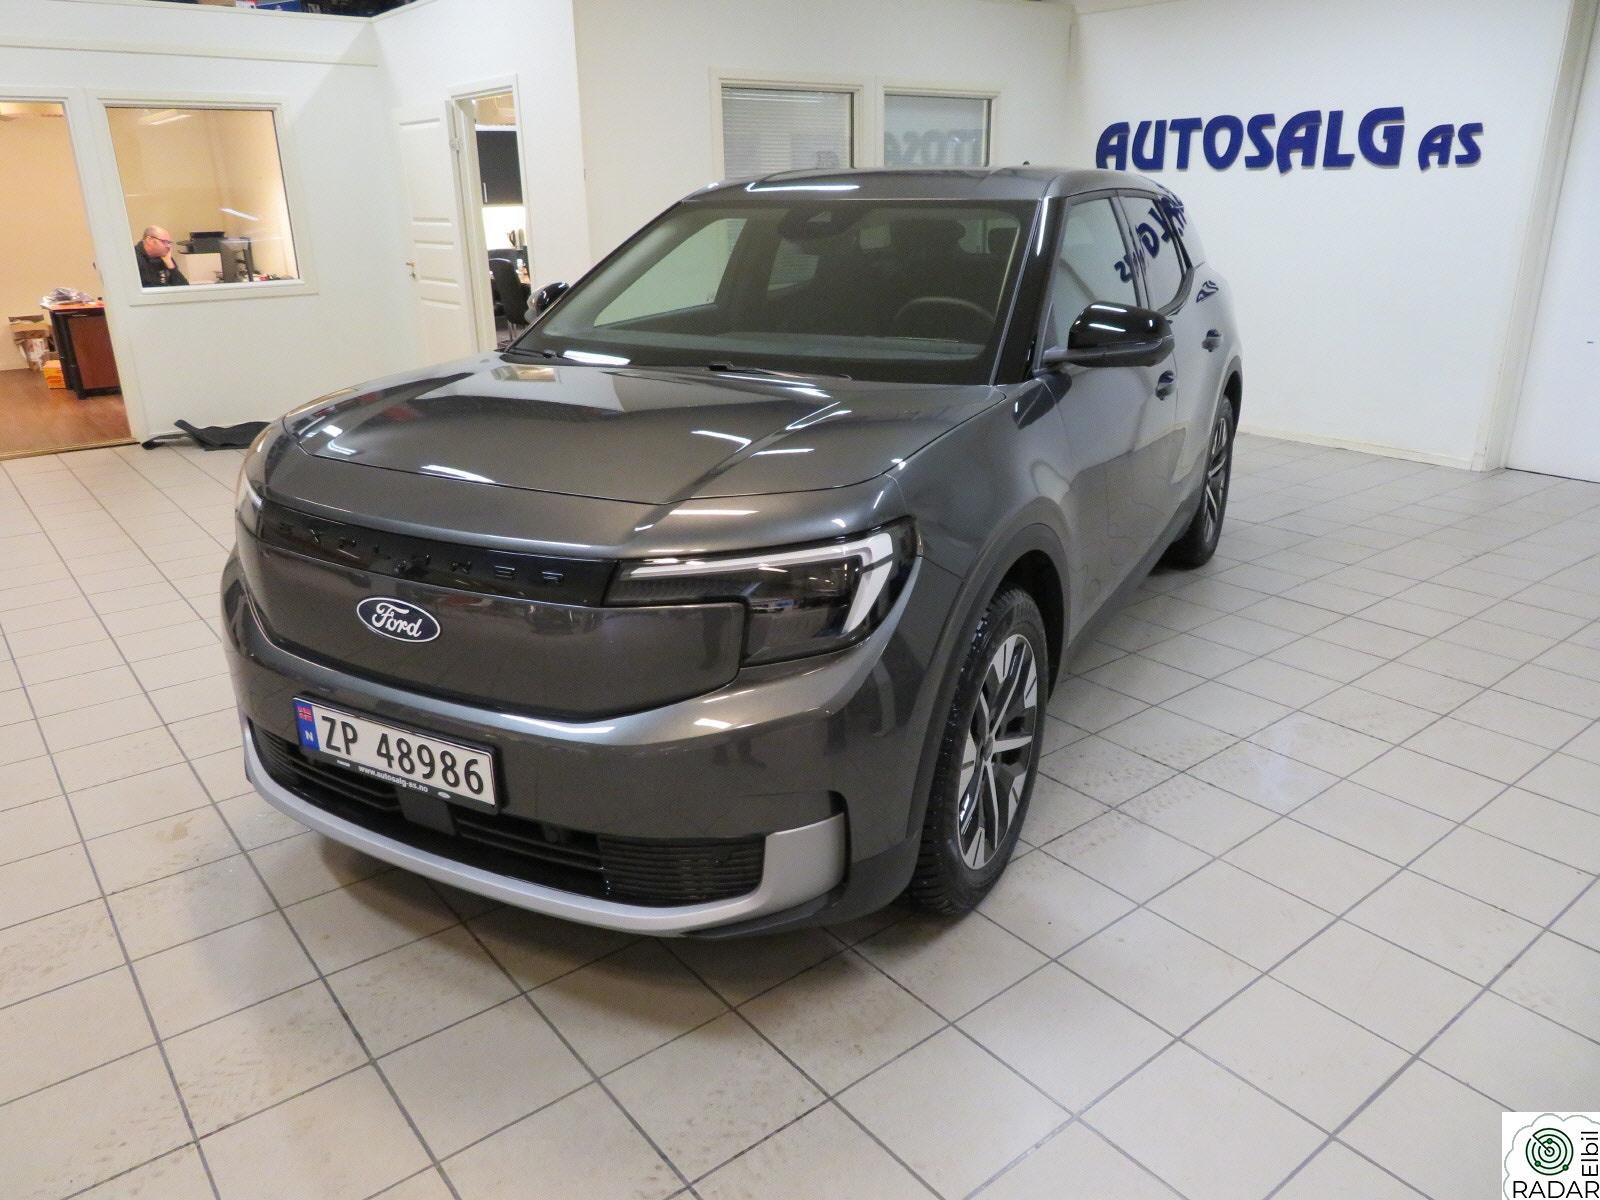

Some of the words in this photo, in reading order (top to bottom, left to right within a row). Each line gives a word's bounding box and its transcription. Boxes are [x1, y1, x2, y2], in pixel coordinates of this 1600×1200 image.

[1096, 106, 1405, 173] AUTOSALG
[1418, 122, 1484, 171] AS
[371, 602, 423, 638] Ford
[304, 730, 314, 742] N
[321, 715, 358, 756] ZP
[376, 732, 484, 795] 48986
[358, 765, 429, 793] www.autosalg-as.no
